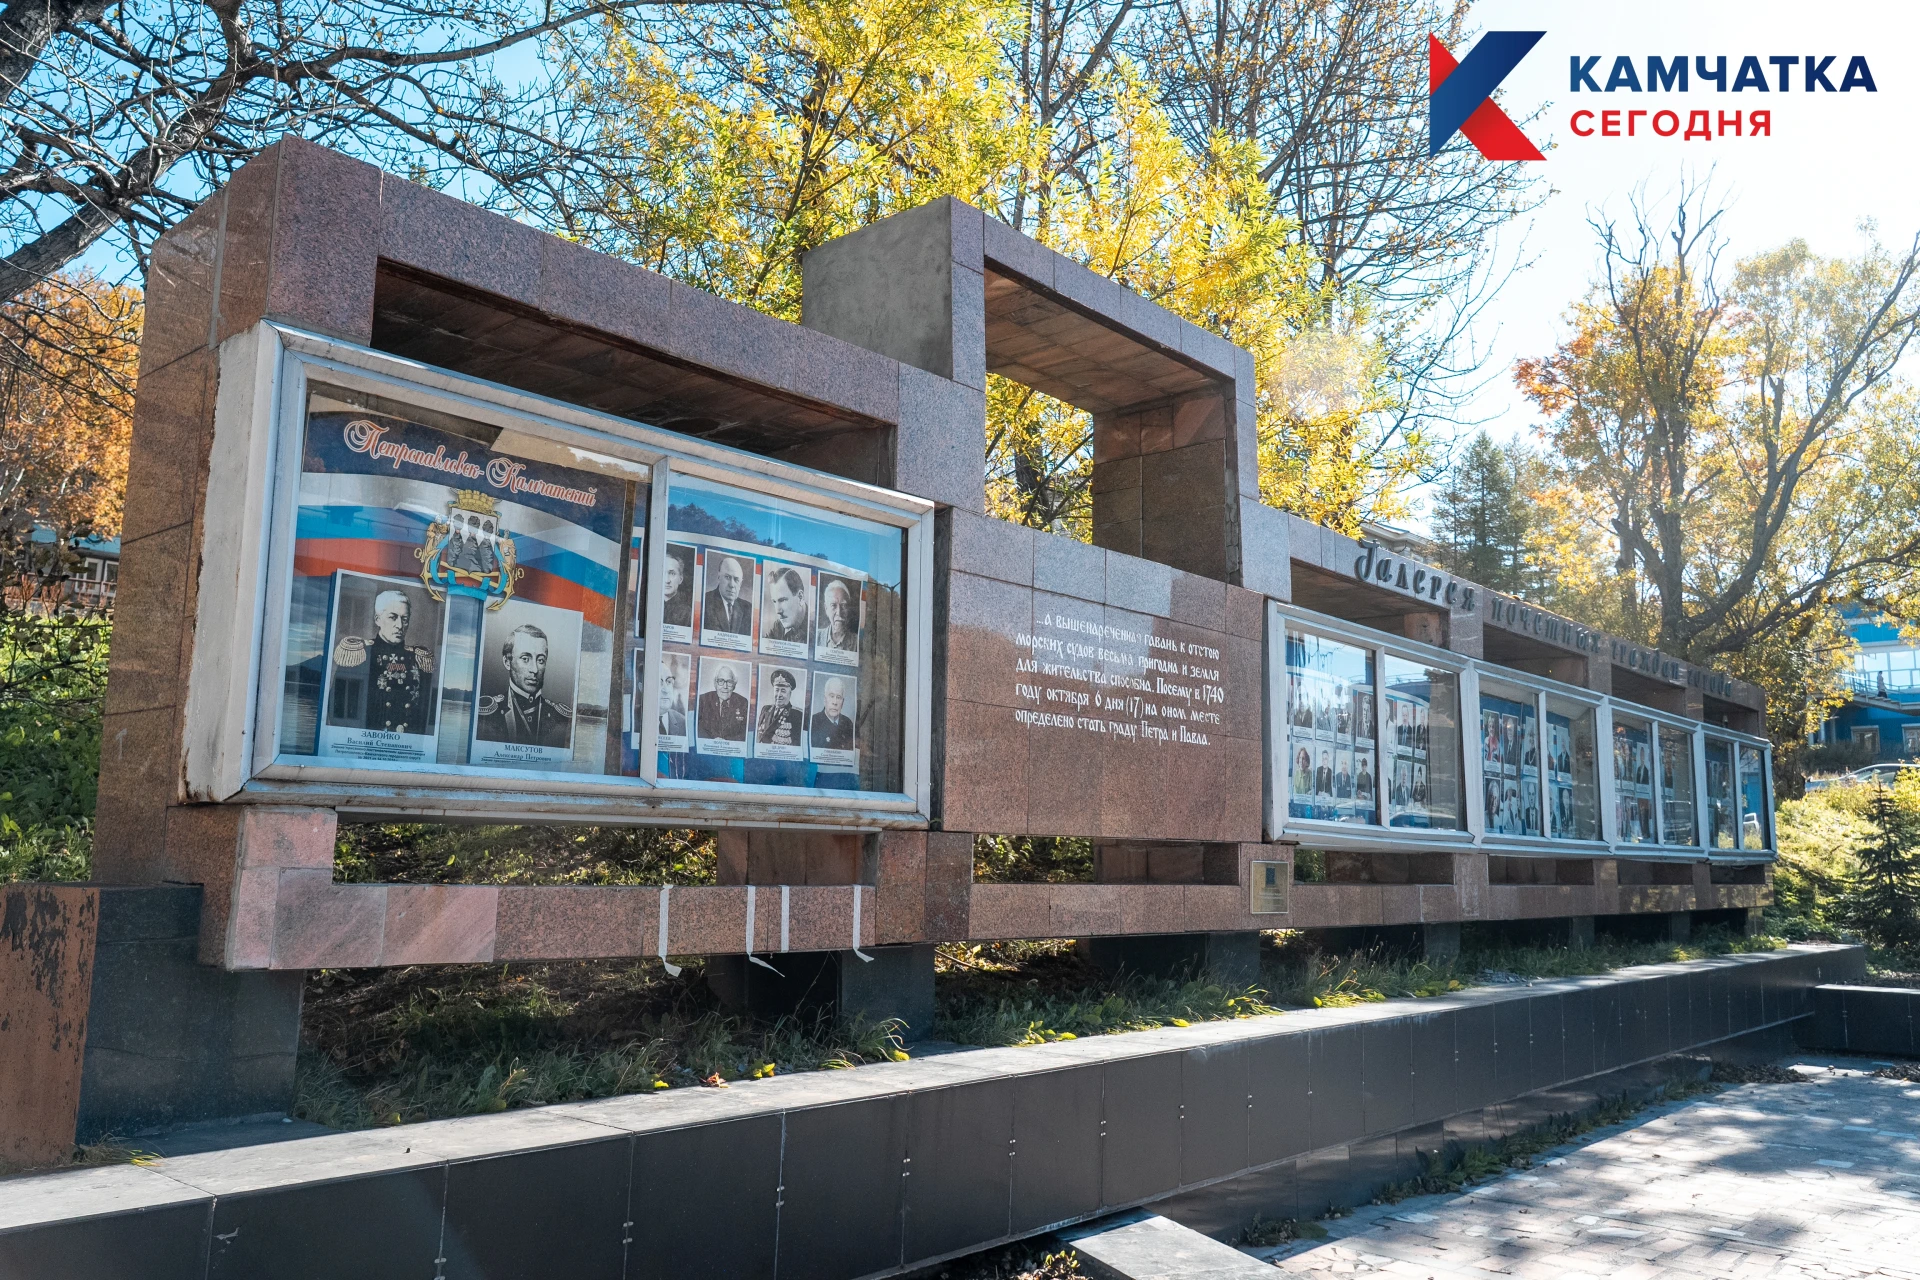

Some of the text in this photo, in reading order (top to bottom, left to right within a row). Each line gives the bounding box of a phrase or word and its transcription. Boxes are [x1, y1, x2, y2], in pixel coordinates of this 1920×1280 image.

[1354, 537, 1475, 611] Галерея
[1491, 596, 1601, 653] почетных
[1015, 632, 1220, 682] морских судов весьма пригодна и земля
[1144, 634, 1178, 652] гавань
[1180, 641, 1186, 653] к
[1188, 643, 1220, 660] отстою
[1015, 657, 1038, 673] для
[1042, 661, 1107, 684] жительства
[1156, 676, 1192, 707] Посему
[1202, 684, 1224, 706] 1740
[1015, 683, 1220, 725] году октября 6 дня (17) на оном месте
[361, 730, 401, 741] ЗАВОЙКО
[1015, 710, 1075, 729] определено
[1077, 717, 1106, 733] стать
[1109, 721, 1138, 743] граду
[1141, 720, 1169, 747] Петра
[1172, 729, 1177, 742] и
[504, 744, 543, 754] МАКСУТОВ
